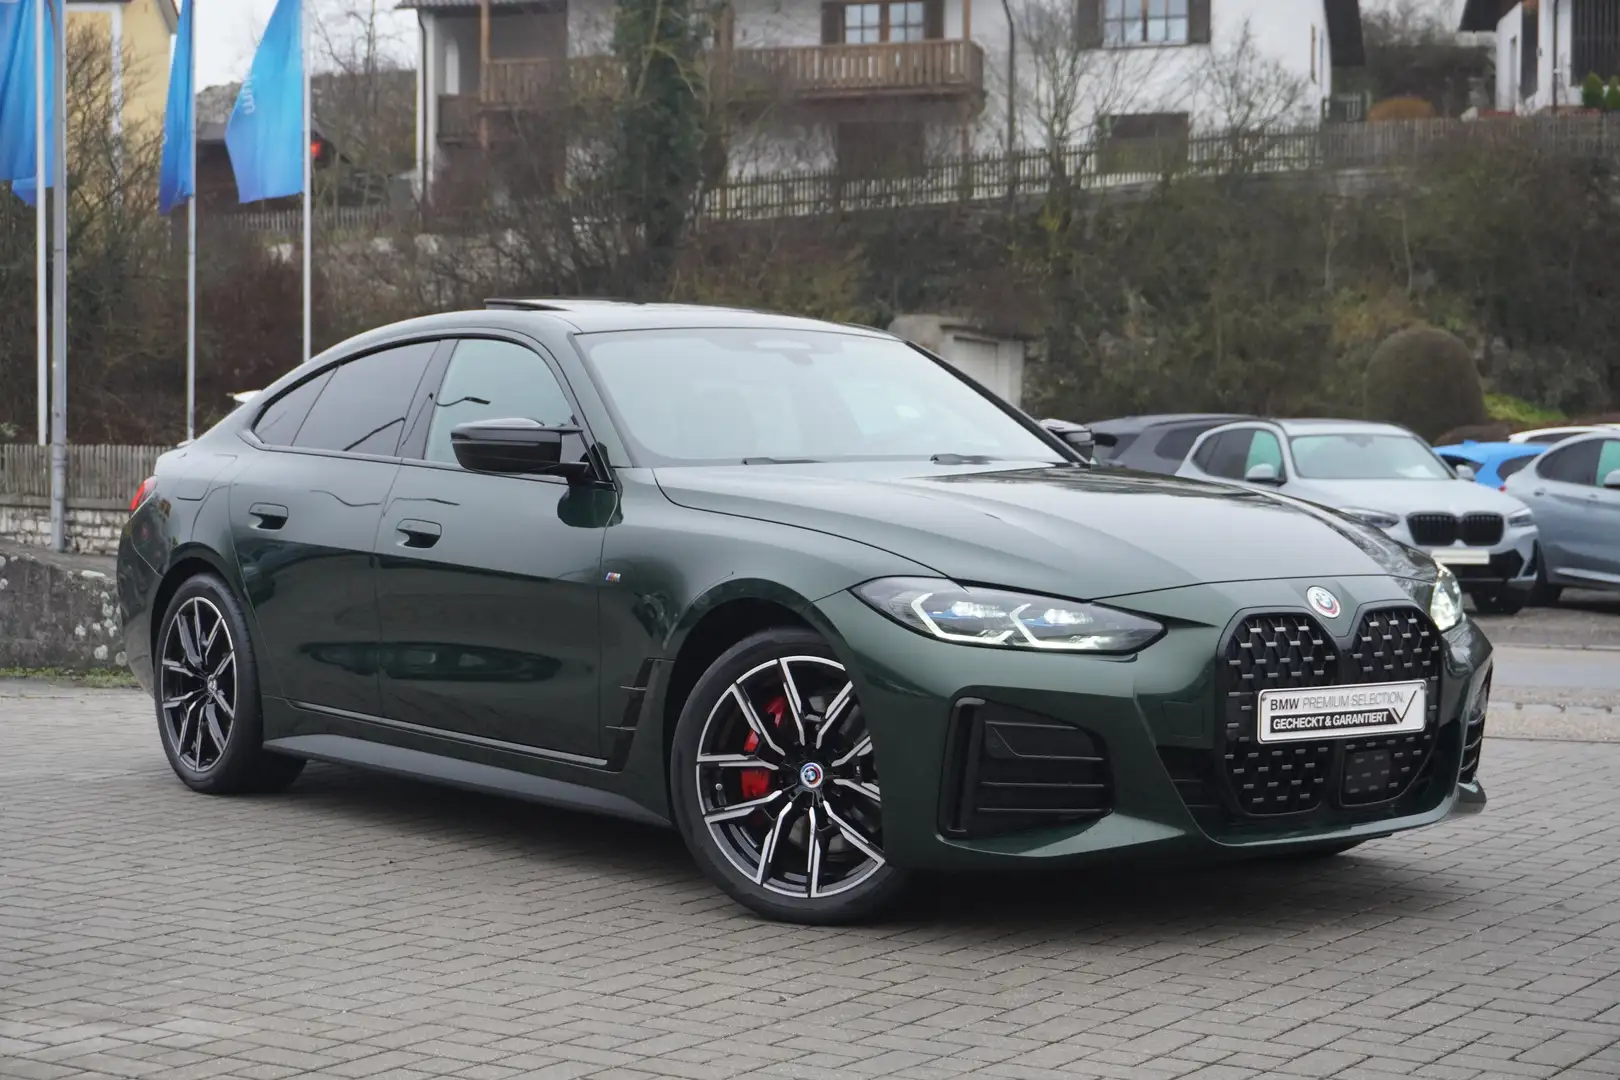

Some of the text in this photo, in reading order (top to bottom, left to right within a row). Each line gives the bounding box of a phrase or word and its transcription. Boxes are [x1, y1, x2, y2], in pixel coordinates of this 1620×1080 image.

[1270, 698, 1299, 711] BMW
[1303, 696, 1349, 709] PREMIUM
[1273, 711, 1389, 730] GECHECKT & GARANTIERT
